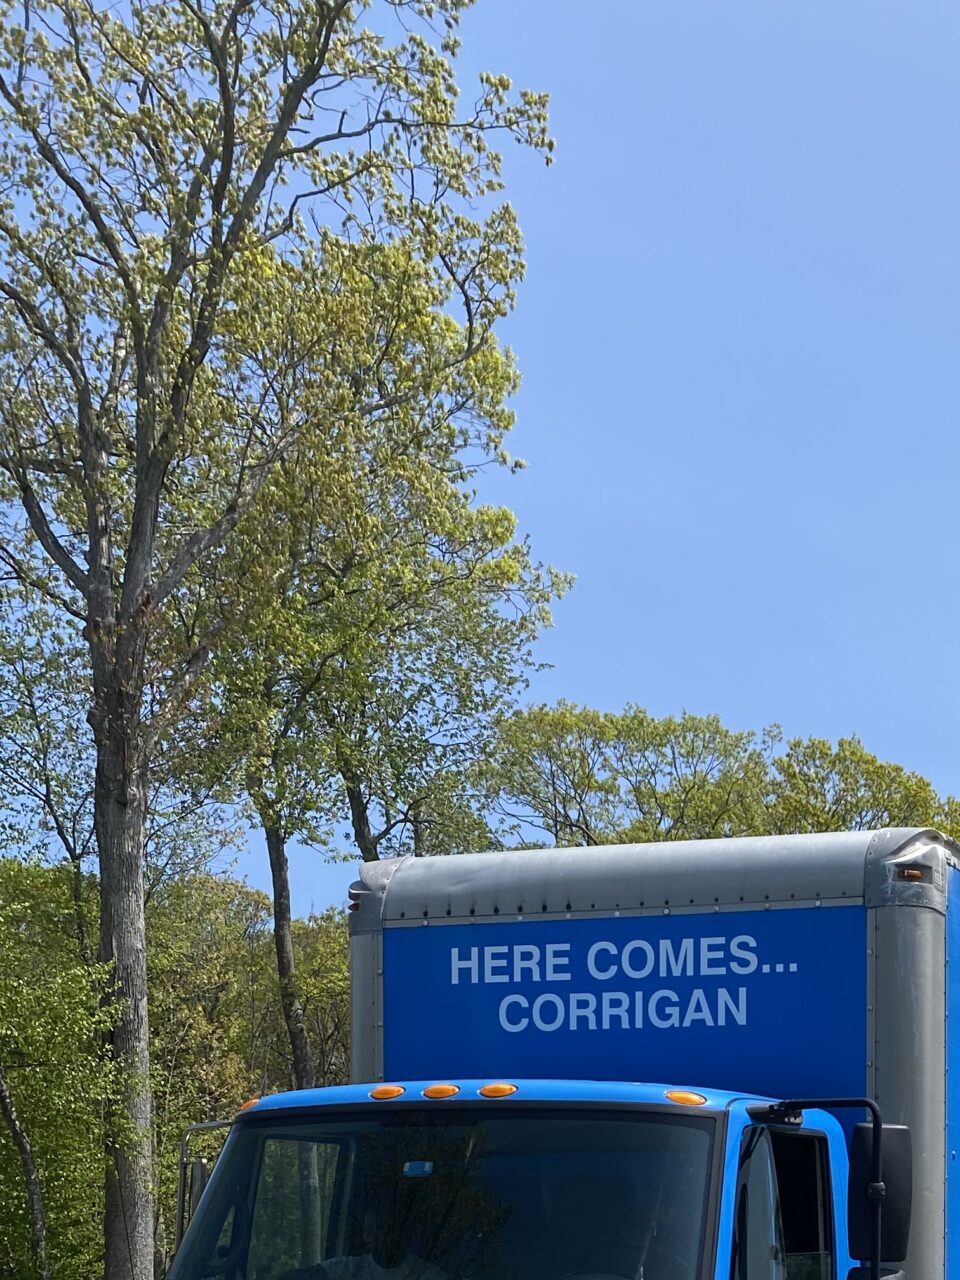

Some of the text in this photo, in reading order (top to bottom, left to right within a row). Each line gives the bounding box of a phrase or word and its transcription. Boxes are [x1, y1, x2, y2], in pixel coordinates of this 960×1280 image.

[450, 935, 799, 984] HERE COMES...
[499, 987, 747, 1033] CORRIGAN
